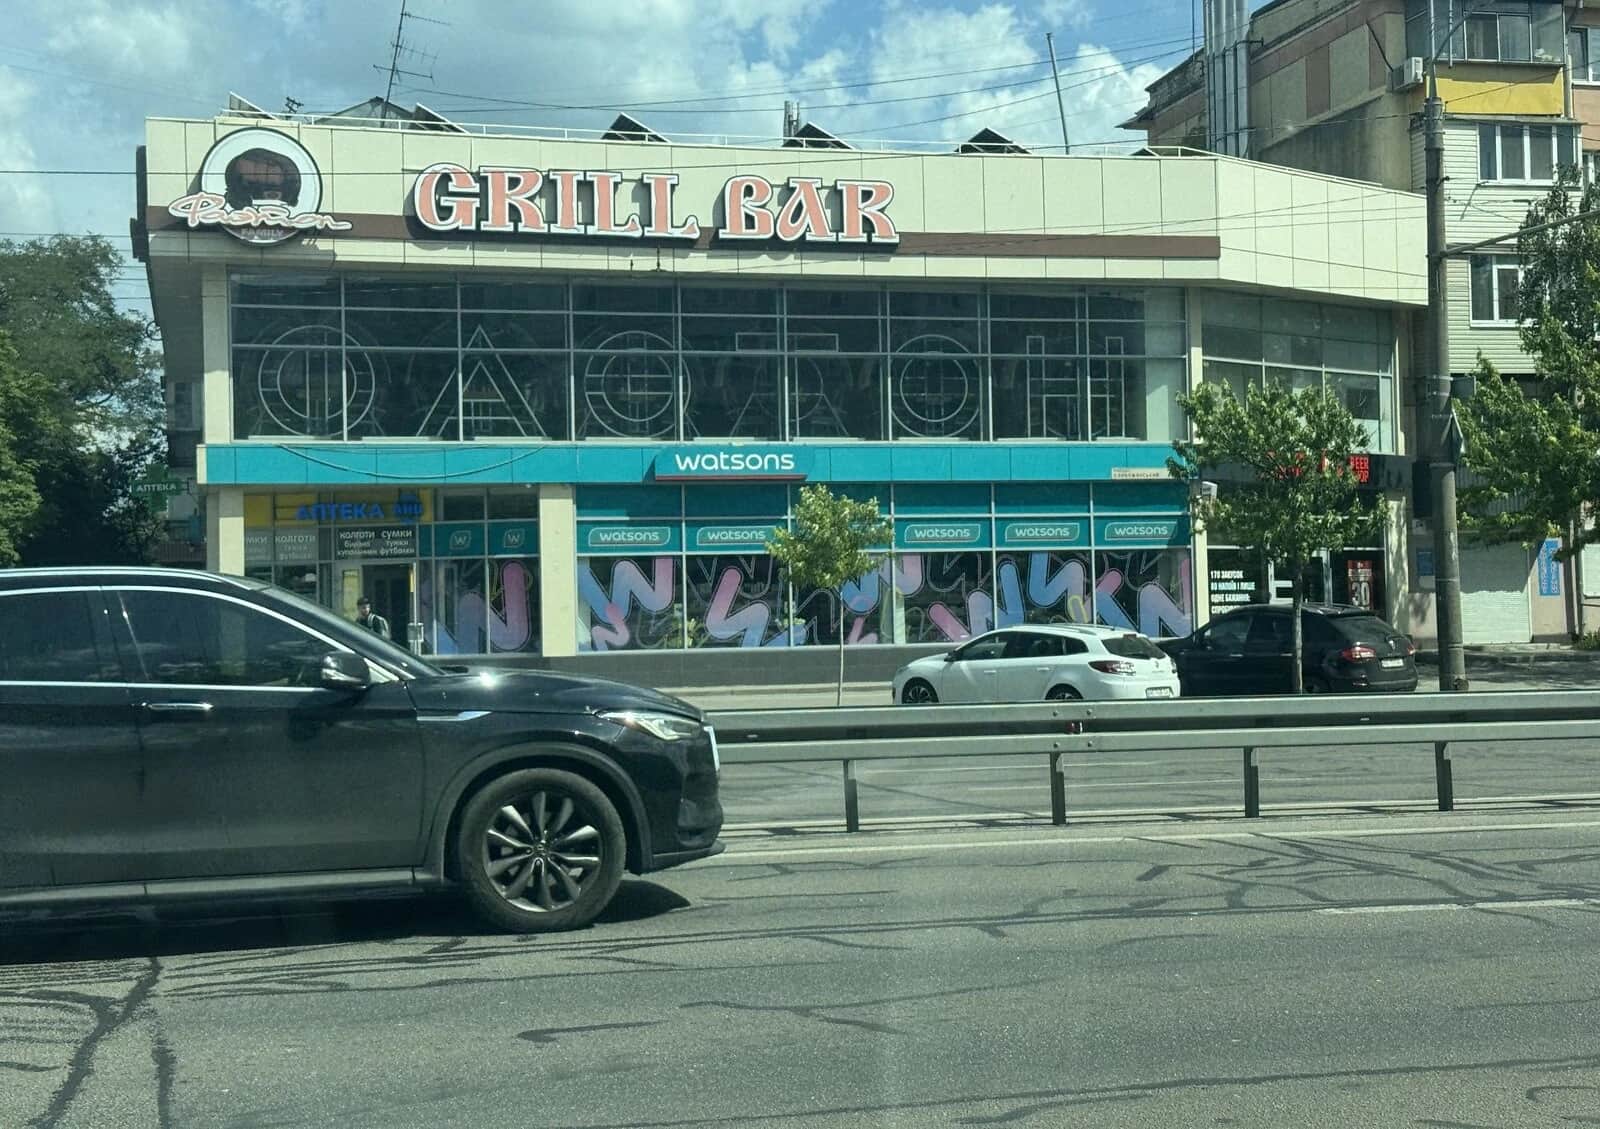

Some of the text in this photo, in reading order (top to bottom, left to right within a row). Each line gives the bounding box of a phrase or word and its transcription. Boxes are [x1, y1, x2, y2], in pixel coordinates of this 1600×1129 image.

[414, 162, 900, 244] GRILL BAR
[241, 228, 284, 239] FAMILY
[675, 451, 795, 471] watsons
[136, 483, 177, 492] АПТЕКА
[296, 503, 385, 521] АПТЕКА
[599, 530, 660, 541] watsons
[707, 529, 766, 541] watsons
[914, 528, 971, 538] watsons
[1015, 527, 1070, 537] watsons
[1114, 525, 1169, 536] watsons
